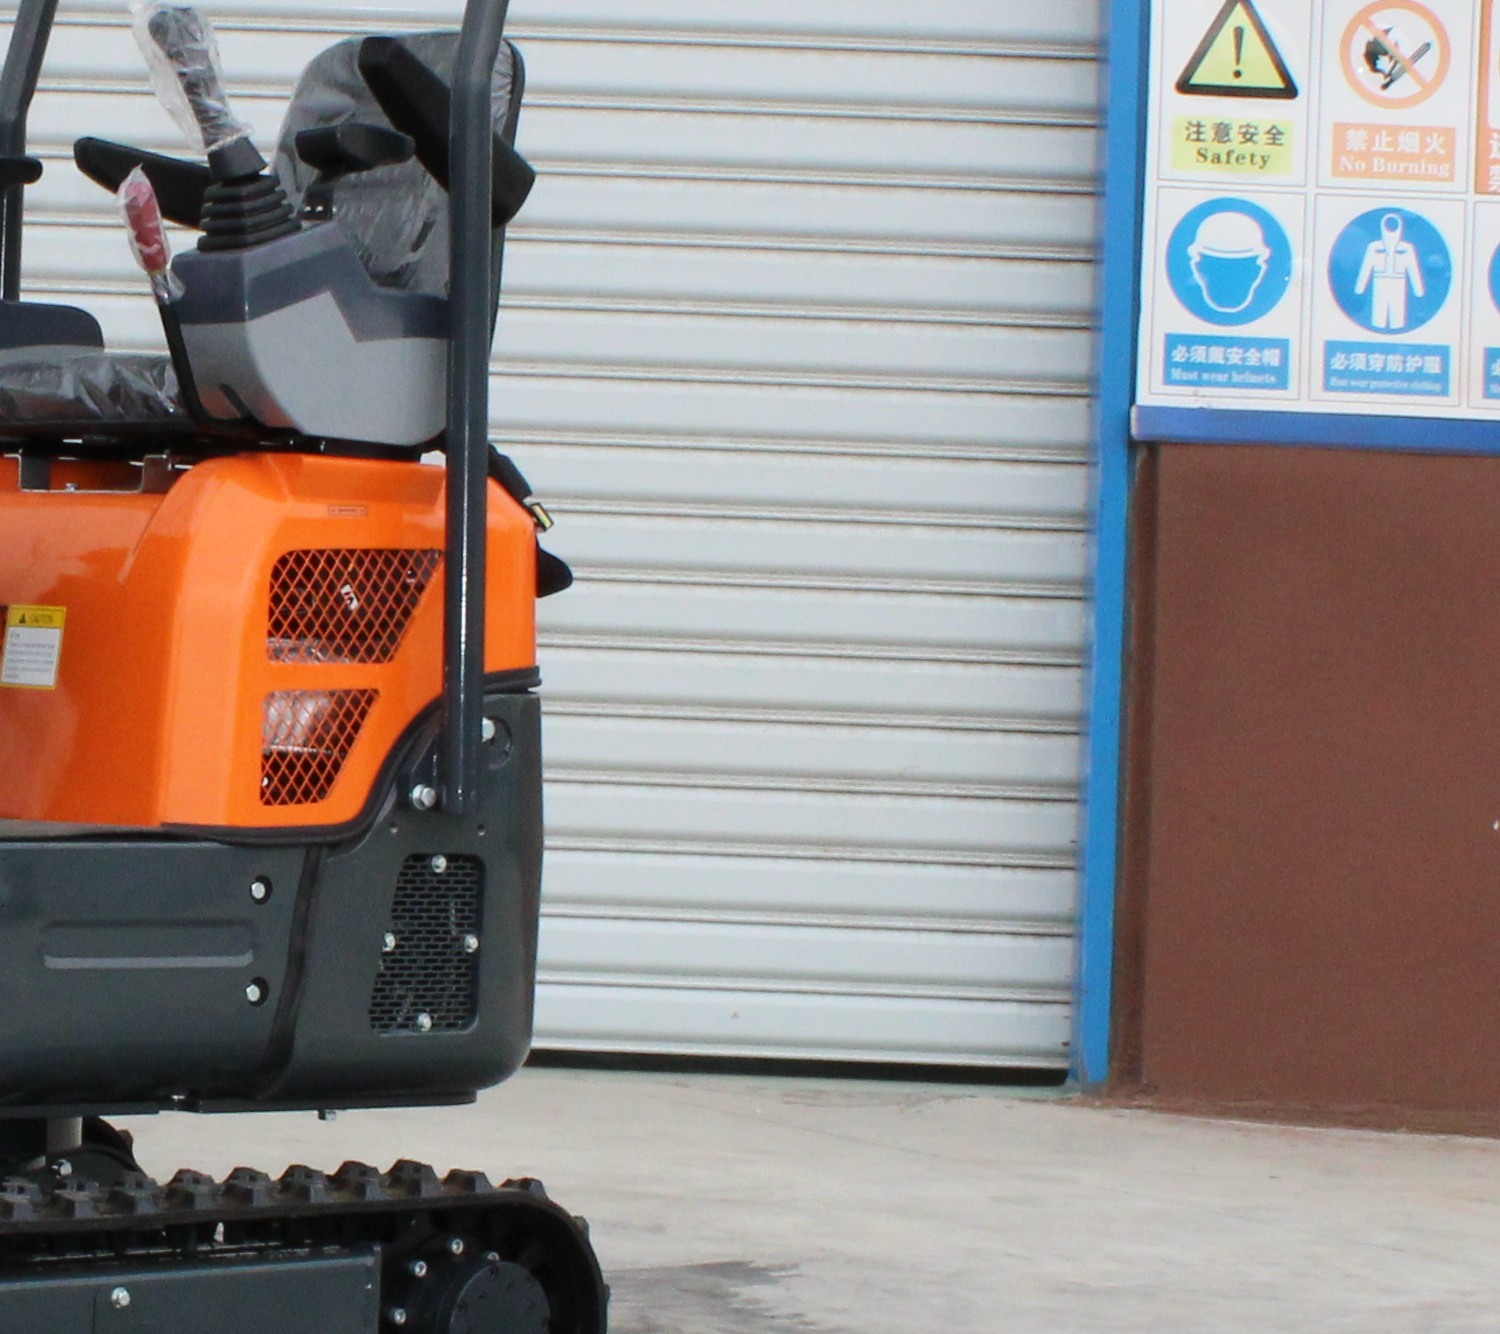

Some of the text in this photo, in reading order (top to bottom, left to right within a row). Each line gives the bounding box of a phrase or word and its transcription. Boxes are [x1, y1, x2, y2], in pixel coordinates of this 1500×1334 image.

[1184, 120, 1285, 146] 注意安全
[1345, 128, 1445, 155] 禁止烟火
[1195, 147, 1271, 170] Safety
[1339, 155, 1450, 178] No Burning
[1171, 344, 1281, 367] 必须戴安全帽
[1330, 351, 1442, 374] 必须穿防护服
[1171, 367, 1277, 384] Must wear helmets
